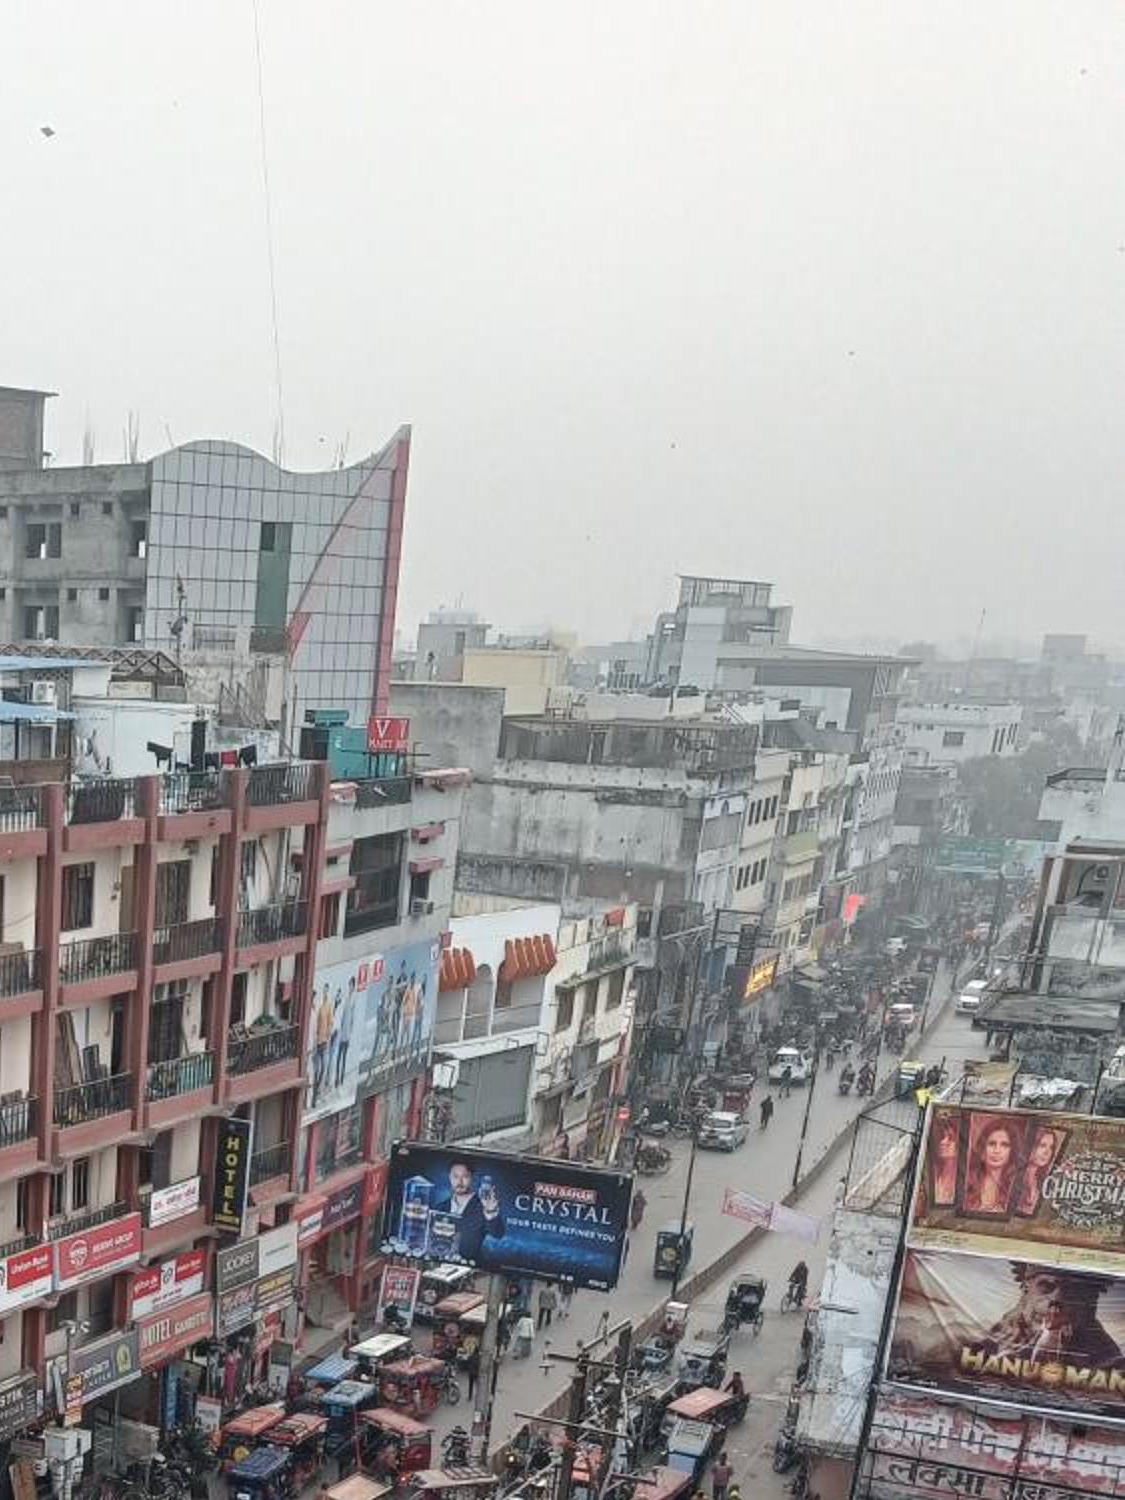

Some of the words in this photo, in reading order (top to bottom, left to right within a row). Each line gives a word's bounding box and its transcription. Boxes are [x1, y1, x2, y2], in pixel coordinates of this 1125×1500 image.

[222, 1136, 240, 1216] HOTEL
[1062, 1169, 1125, 1187] MERRY
[535, 1183, 558, 1197] PAN
[514, 1194, 613, 1226] CRYSTAL
[597, 1230, 617, 1243] YOU
